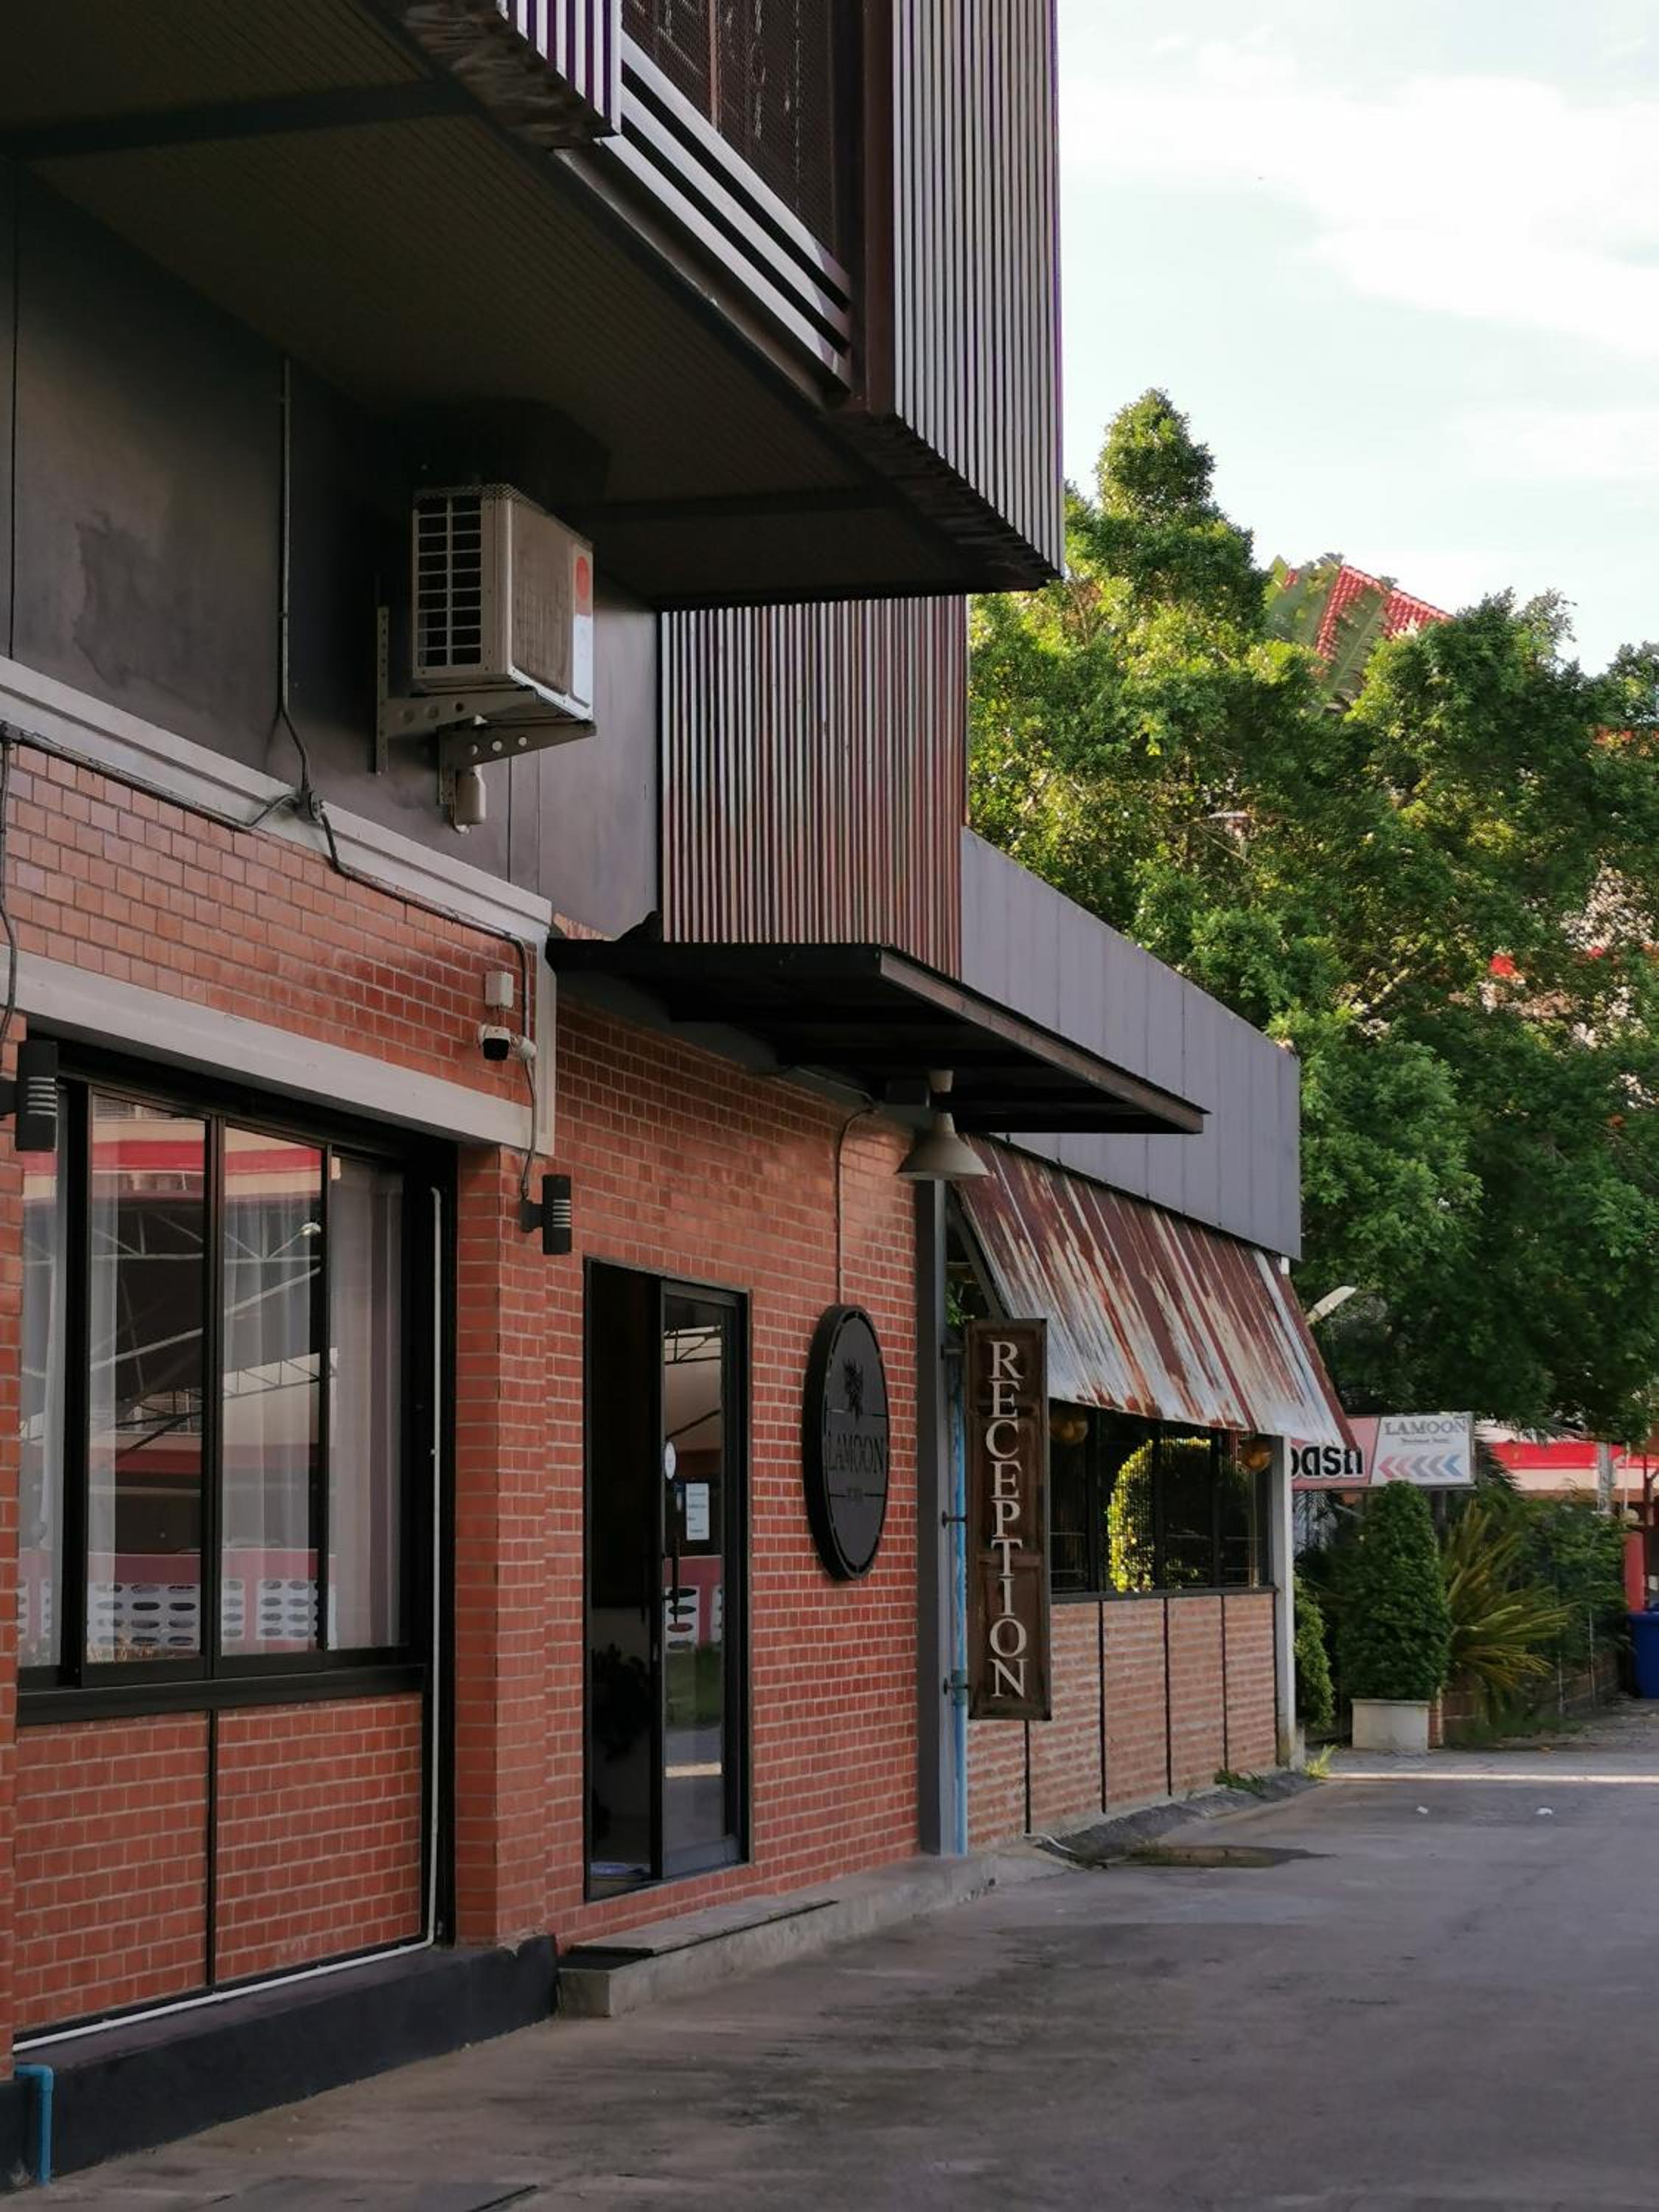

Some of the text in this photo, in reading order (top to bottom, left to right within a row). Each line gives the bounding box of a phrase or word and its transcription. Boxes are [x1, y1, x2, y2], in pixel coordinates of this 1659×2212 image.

[1383, 1420, 1467, 1436] LAMOON
[825, 1430, 885, 1475] LAMOON
[986, 1341, 1028, 1697] RECEPTION
